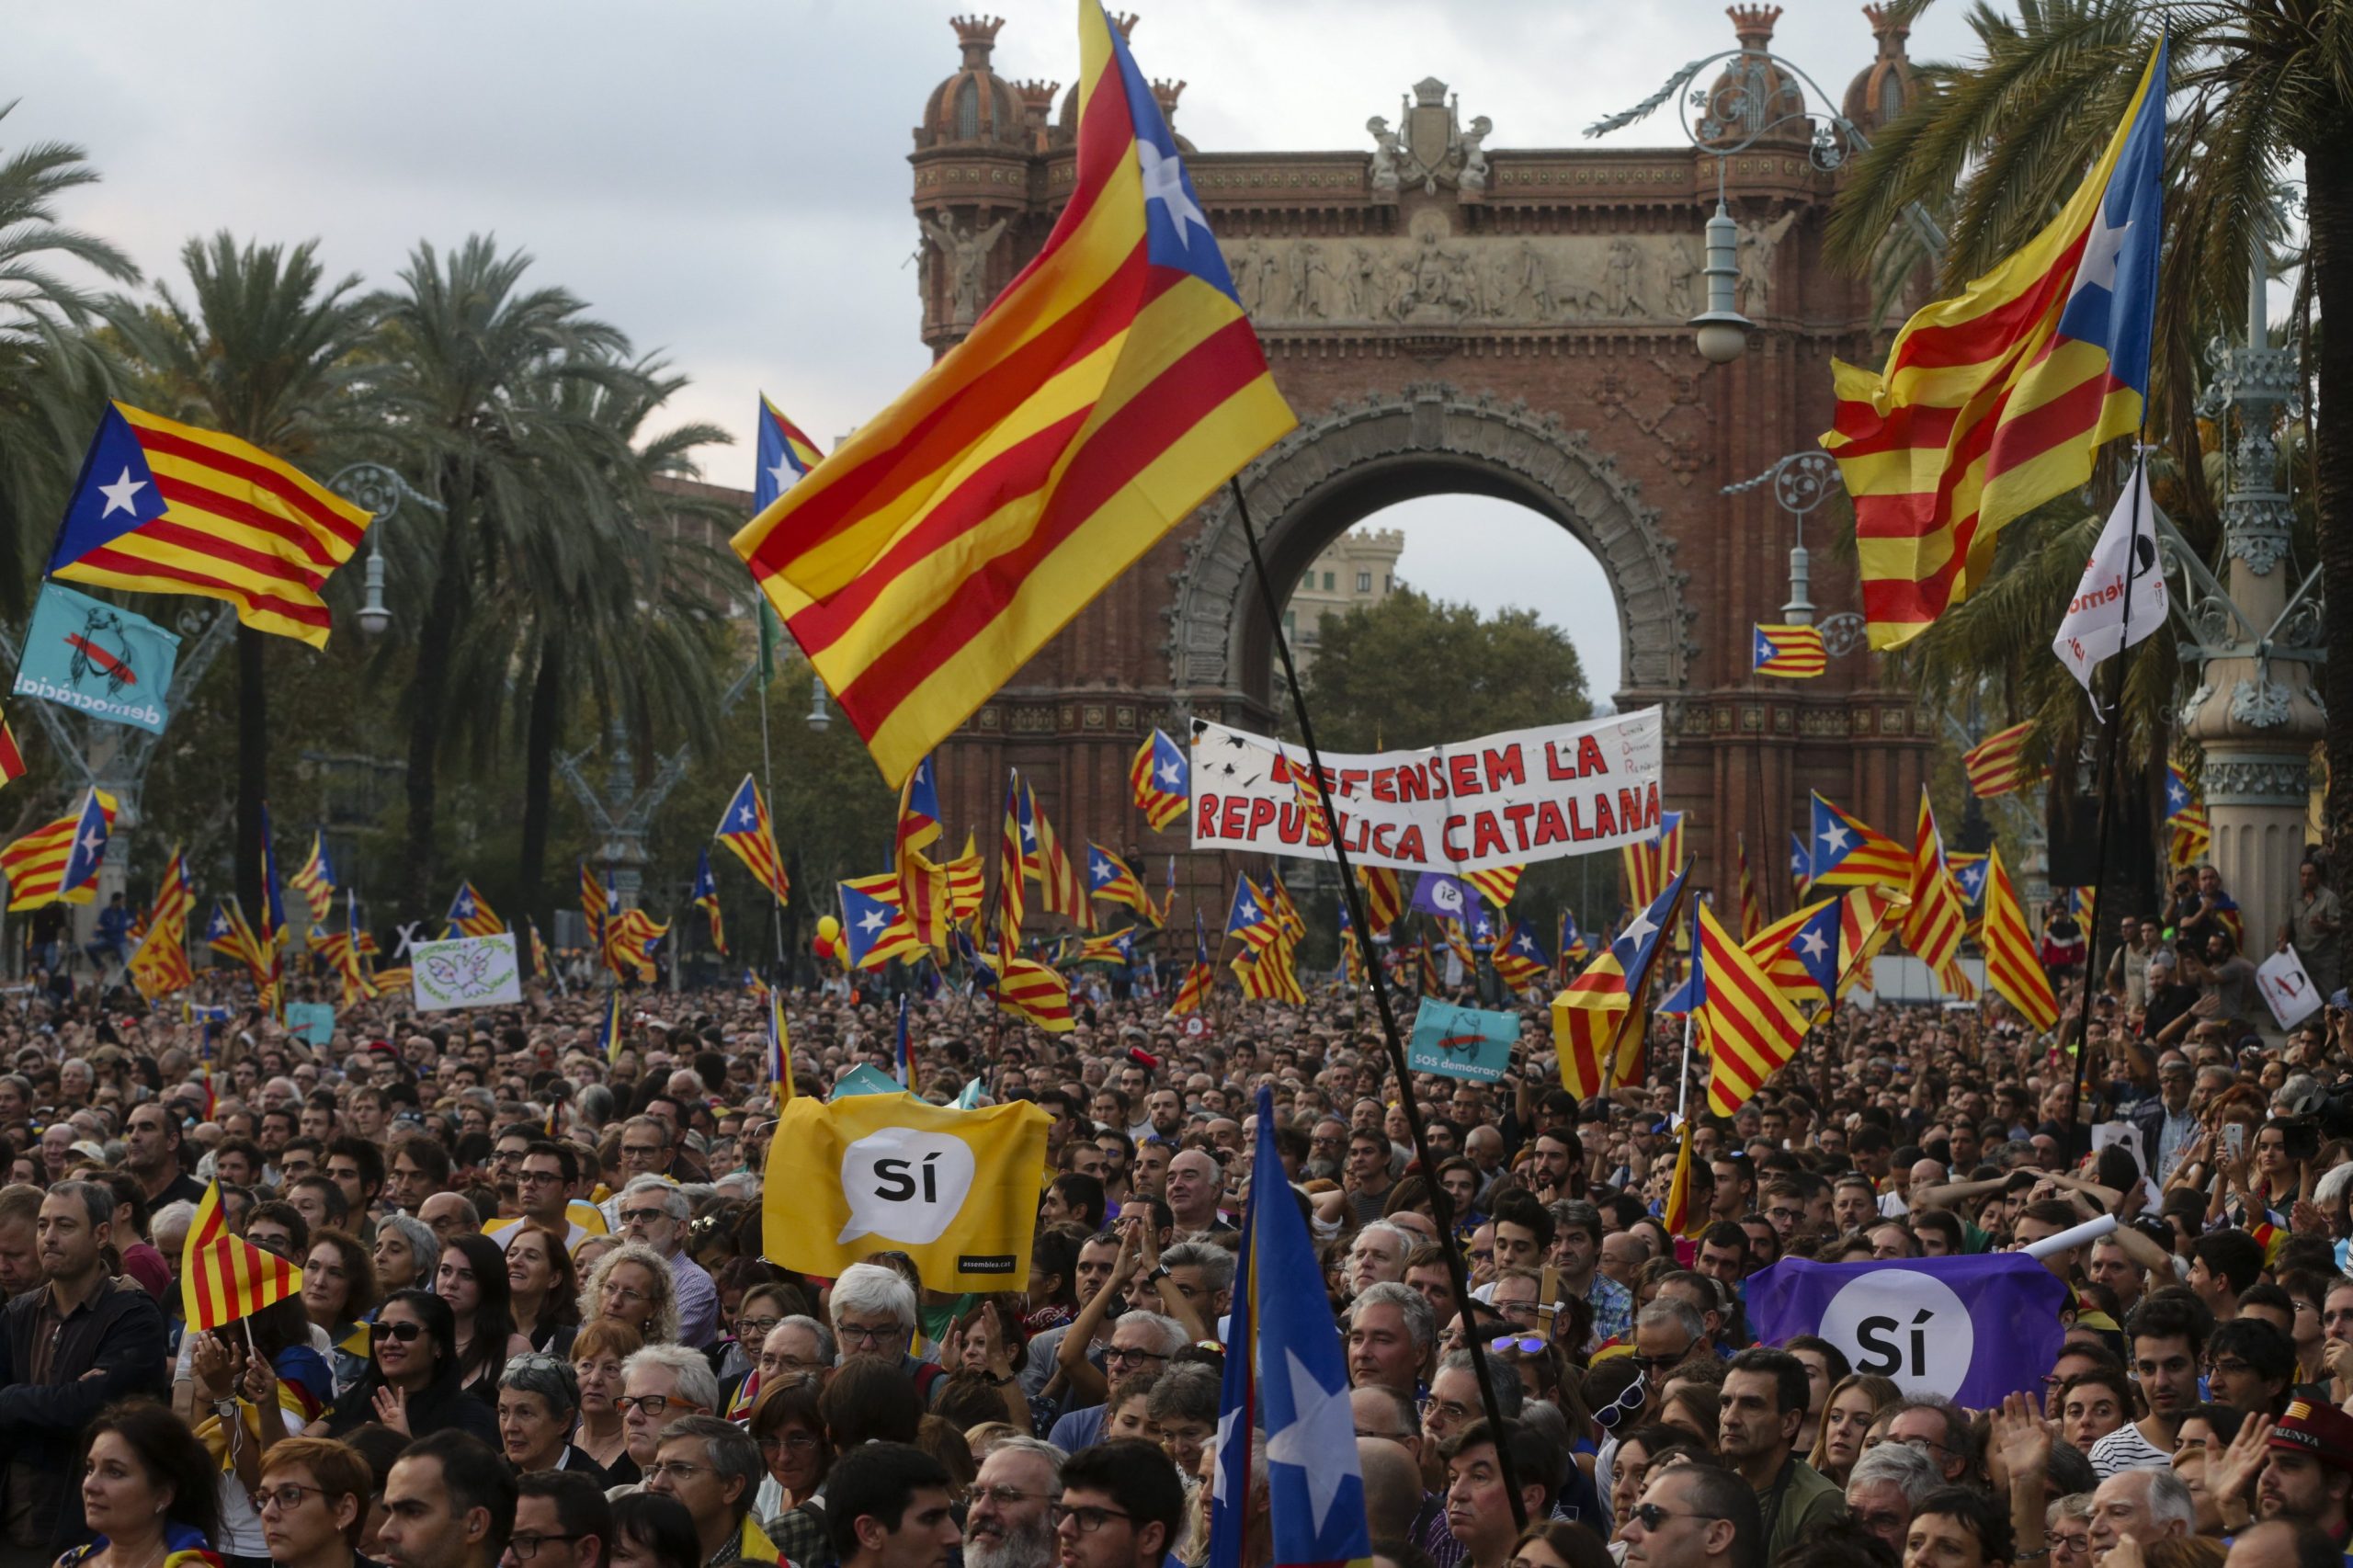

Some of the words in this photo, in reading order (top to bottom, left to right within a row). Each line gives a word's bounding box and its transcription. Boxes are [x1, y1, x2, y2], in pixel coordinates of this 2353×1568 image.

[1545, 734, 1608, 781] LA
[1442, 781, 1660, 862] CATALANA
[1415, 1054, 1438, 1067] SOS
